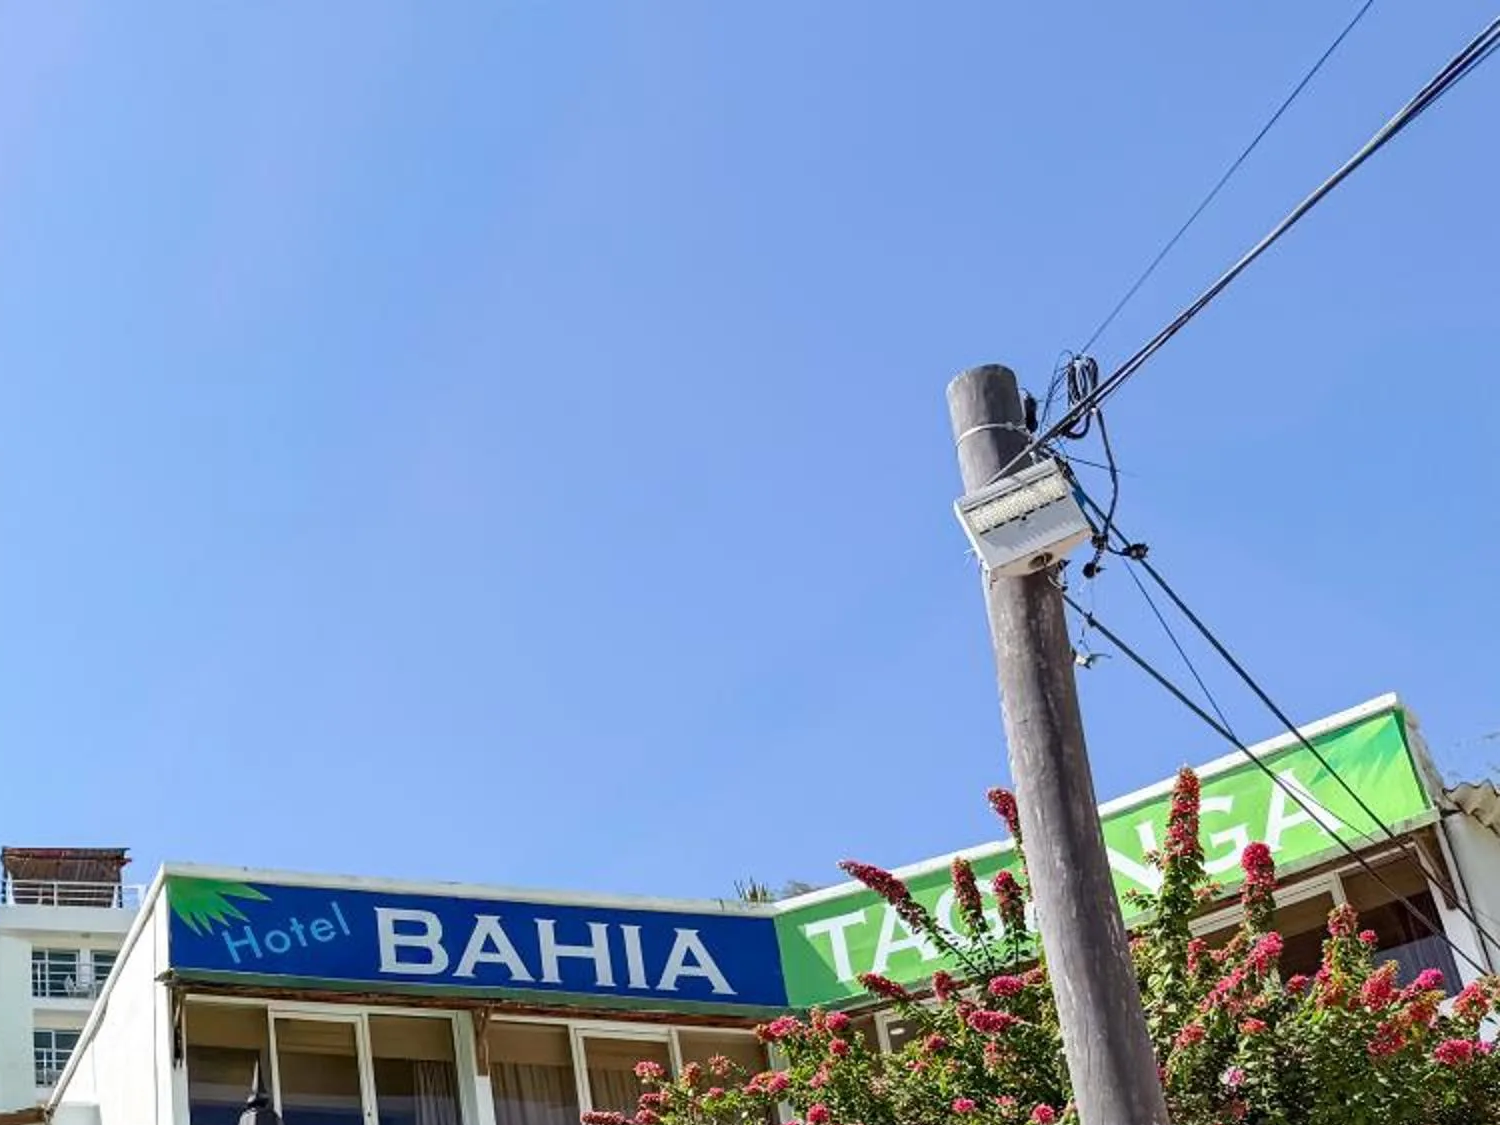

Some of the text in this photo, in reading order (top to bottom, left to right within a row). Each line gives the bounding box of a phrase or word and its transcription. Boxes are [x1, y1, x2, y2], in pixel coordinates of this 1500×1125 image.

[221, 901, 737, 996] Hotel BAHIA
[804, 767, 1343, 983] TAGNGA
